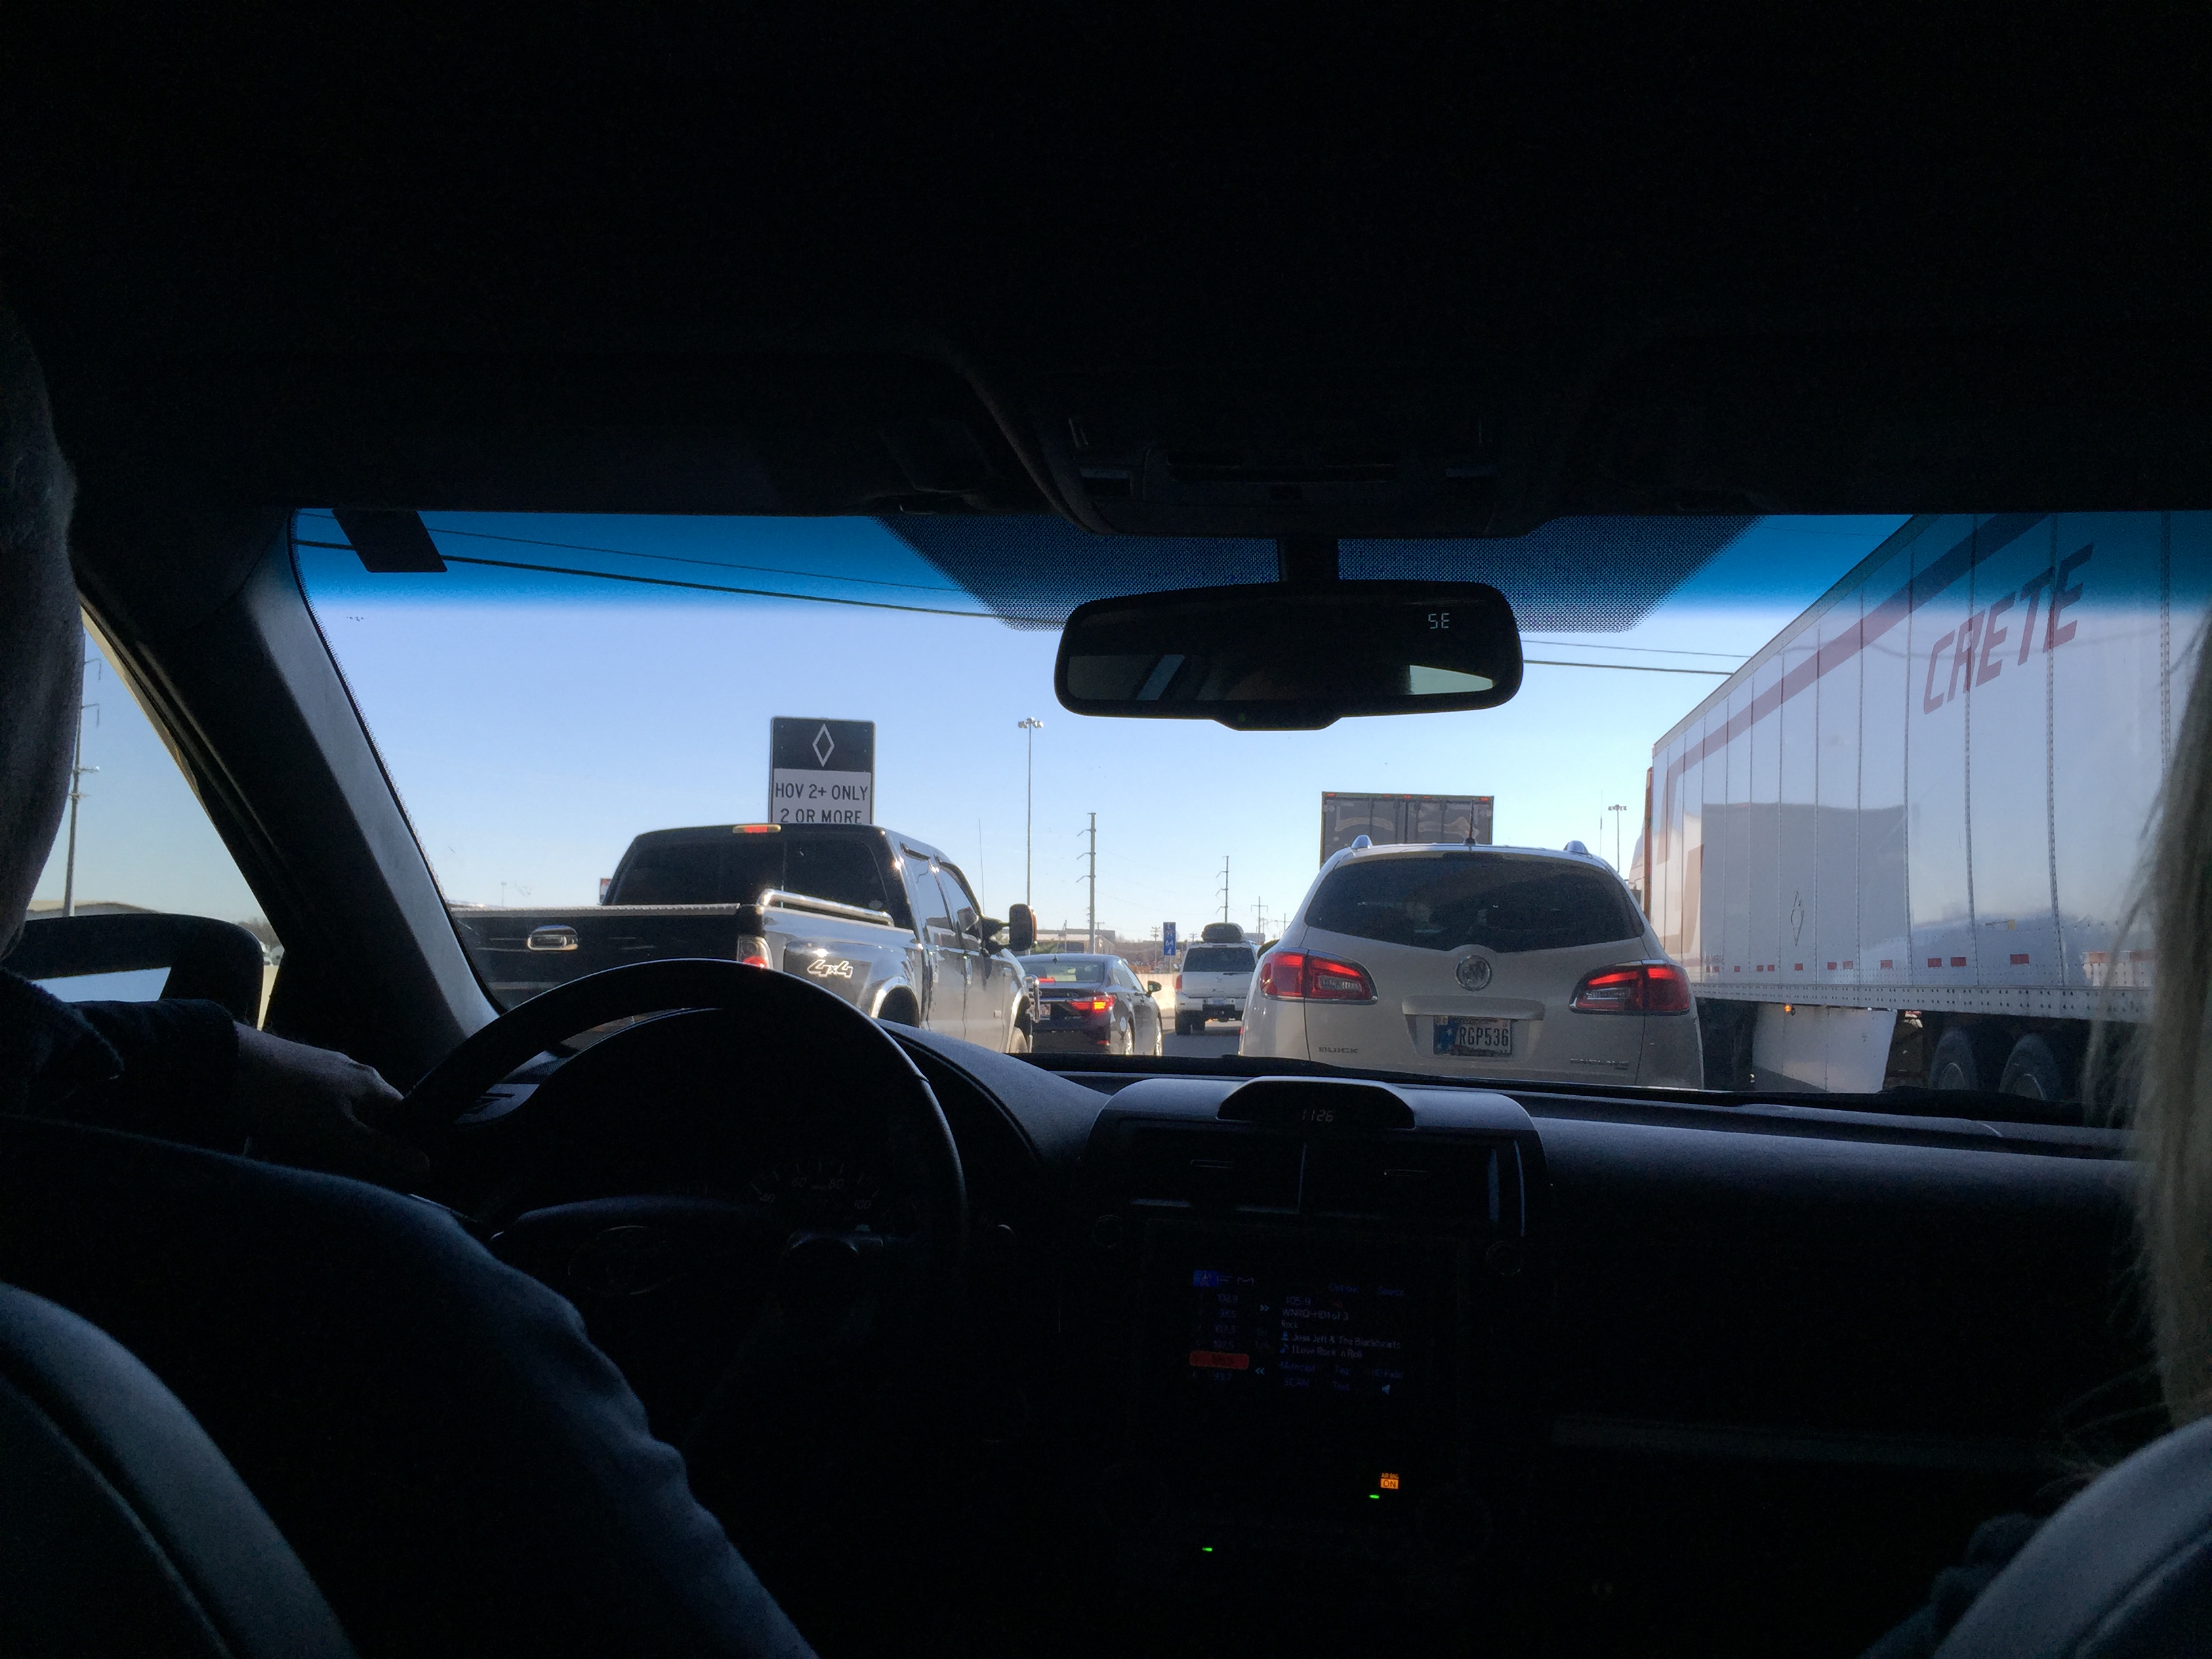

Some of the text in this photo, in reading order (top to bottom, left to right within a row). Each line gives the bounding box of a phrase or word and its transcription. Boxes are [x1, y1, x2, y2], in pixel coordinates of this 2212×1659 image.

[1428, 613, 1450, 629] SE
[1923, 542, 2093, 715] CRETE
[775, 783, 868, 801] HOV 2+ ONLY
[780, 808, 862, 824] 2 OR MORE
[807, 960, 853, 979] 4x4
[1458, 1027, 1509, 1046] RGP536
[1281, 1319, 1299, 1328] Rock
[1338, 1336, 1353, 1346] The
[1296, 1345, 1315, 1355] Love
[1317, 1347, 1337, 1356] Rock
[1383, 1480, 1397, 1488] ON
